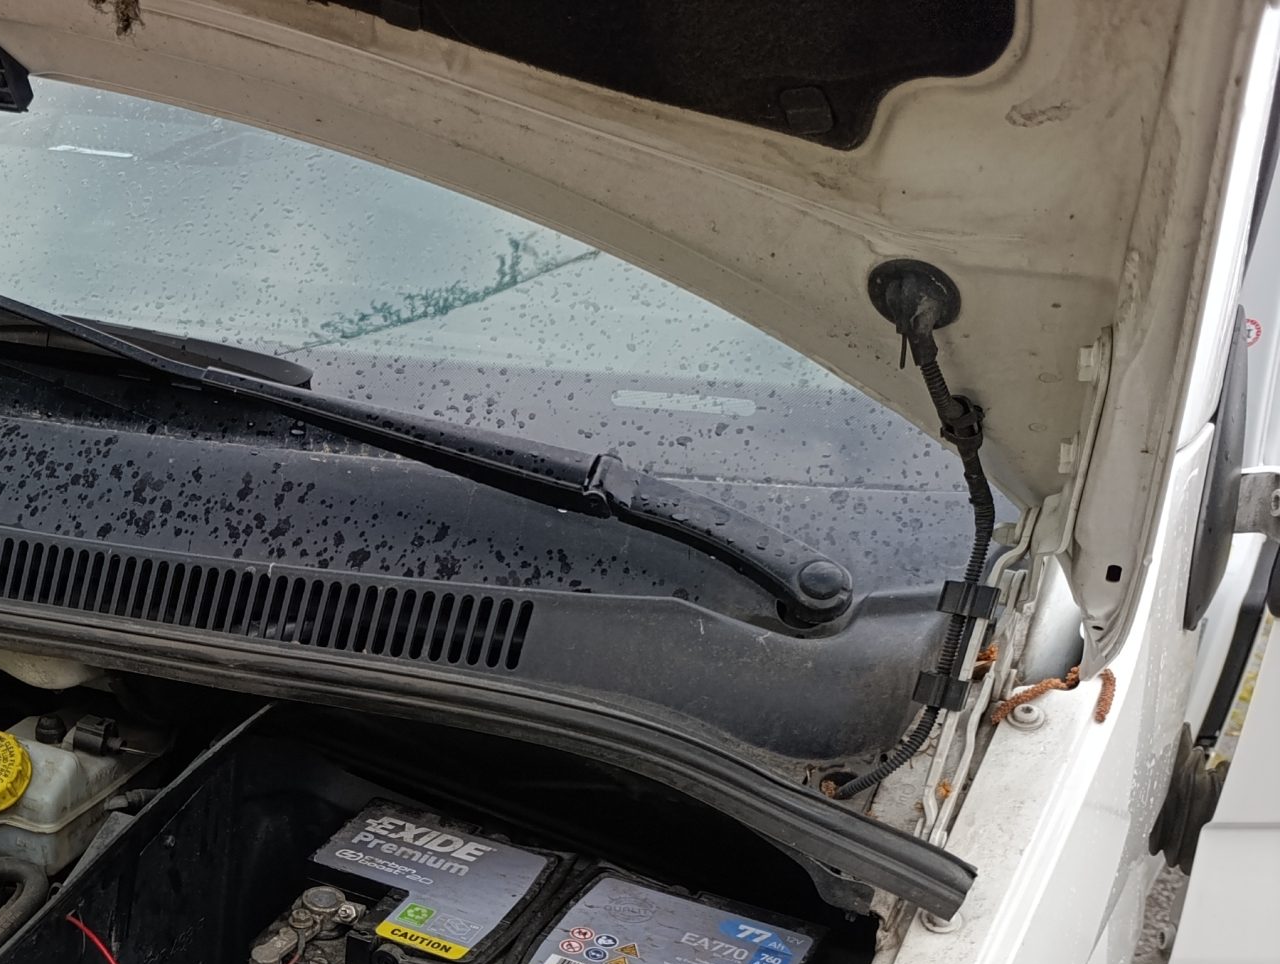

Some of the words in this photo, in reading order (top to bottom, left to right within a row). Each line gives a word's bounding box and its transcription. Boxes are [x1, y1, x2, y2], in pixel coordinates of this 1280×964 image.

[365, 816, 493, 862] EXIDE
[351, 832, 470, 877] Premium
[390, 928, 452, 954] CAUTION
[680, 932, 749, 961] EA770
[736, 924, 772, 943] 77
